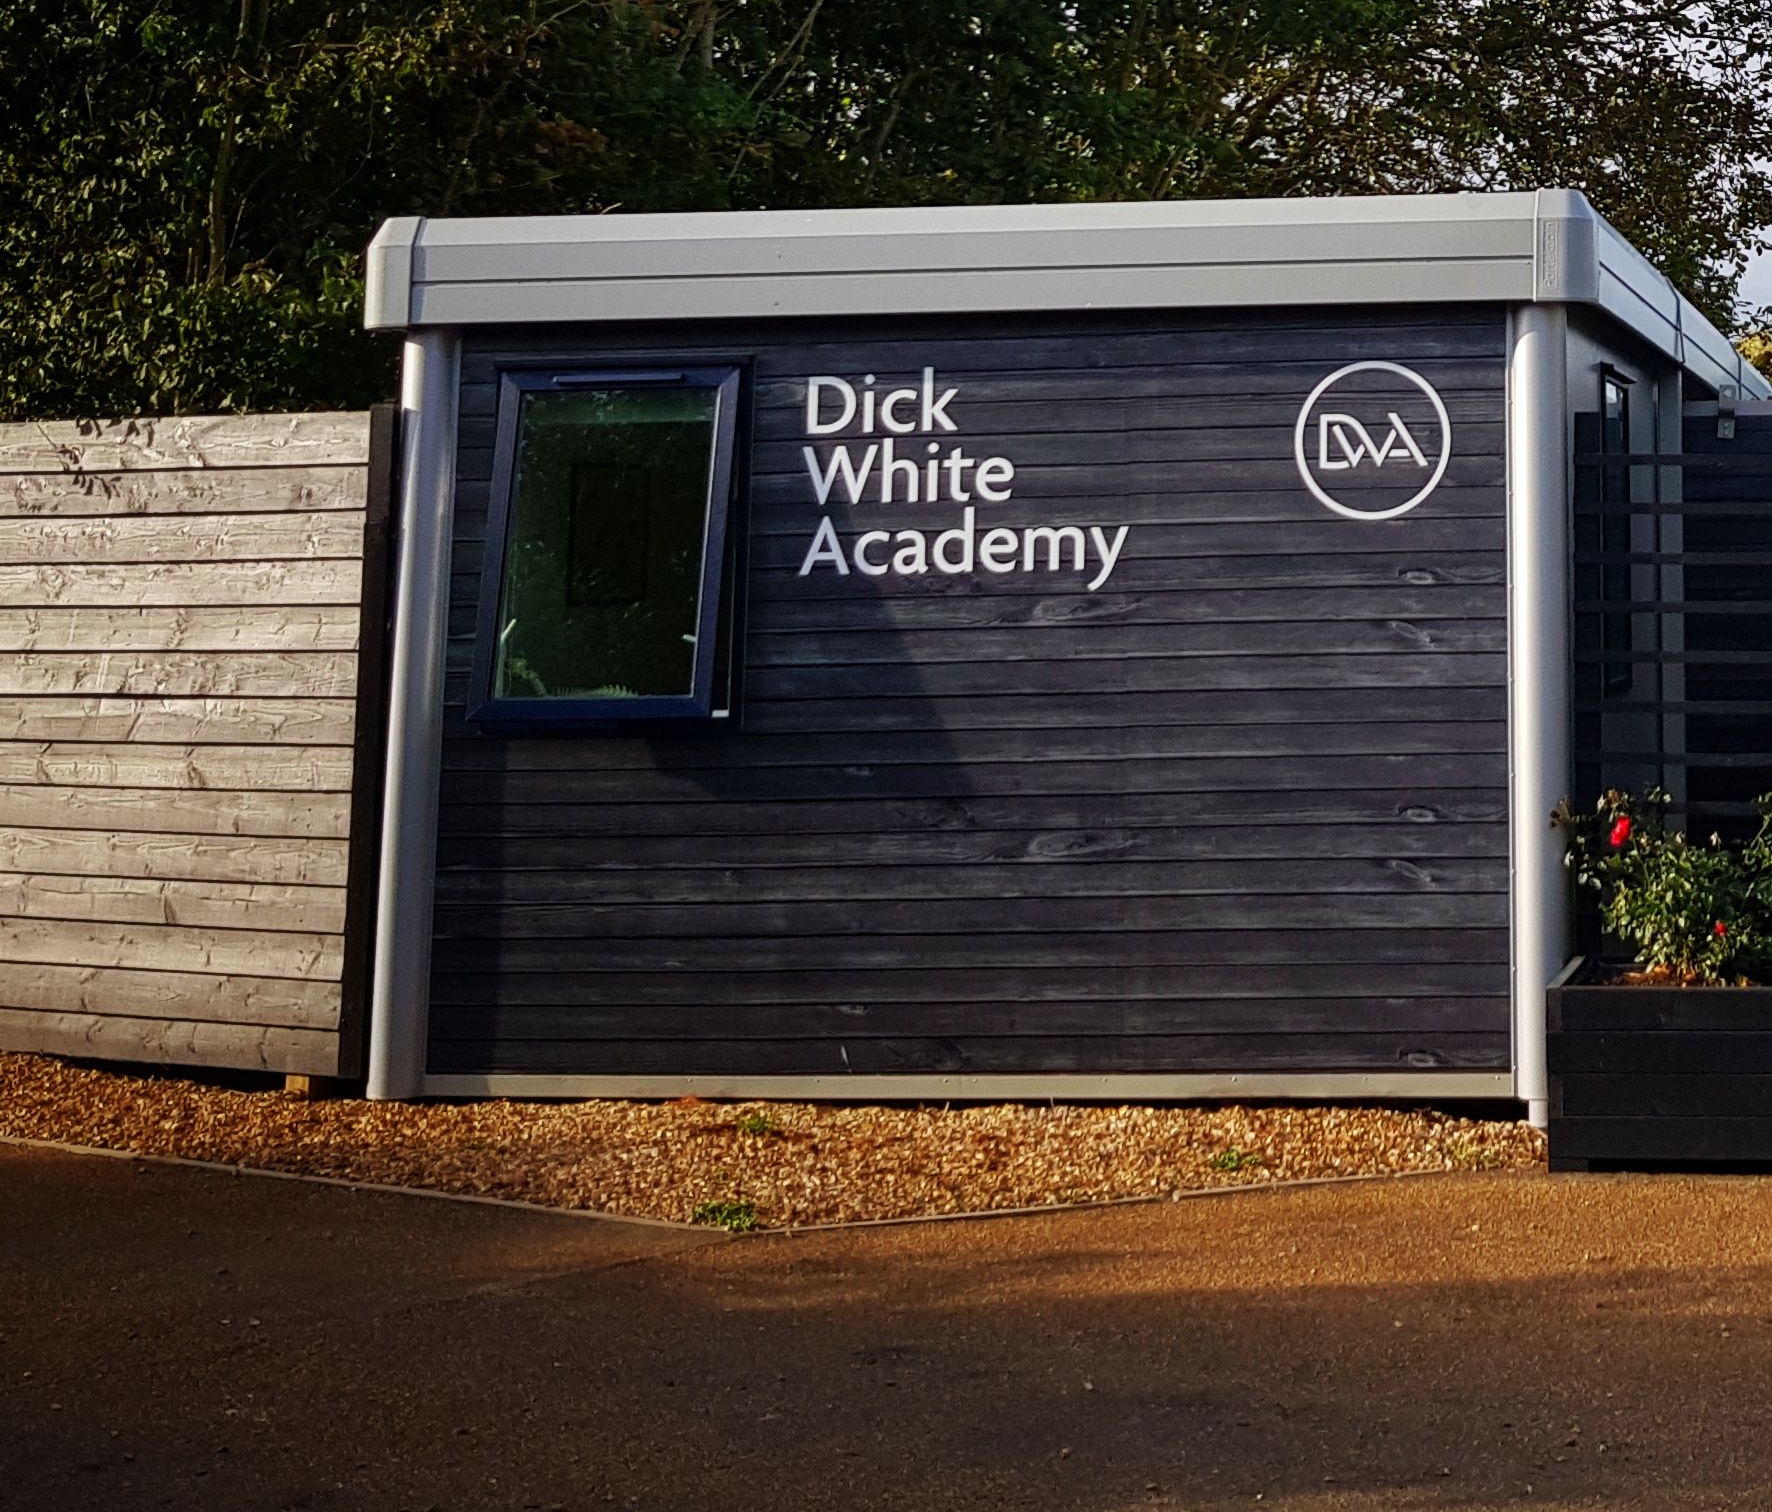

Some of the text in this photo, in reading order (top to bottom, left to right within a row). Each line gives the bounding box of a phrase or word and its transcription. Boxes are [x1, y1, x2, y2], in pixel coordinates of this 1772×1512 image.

[806, 366, 959, 435] Dick
[803, 437, 1015, 505] White
[1318, 412, 1429, 470] DWA
[799, 506, 1130, 592] Academy
